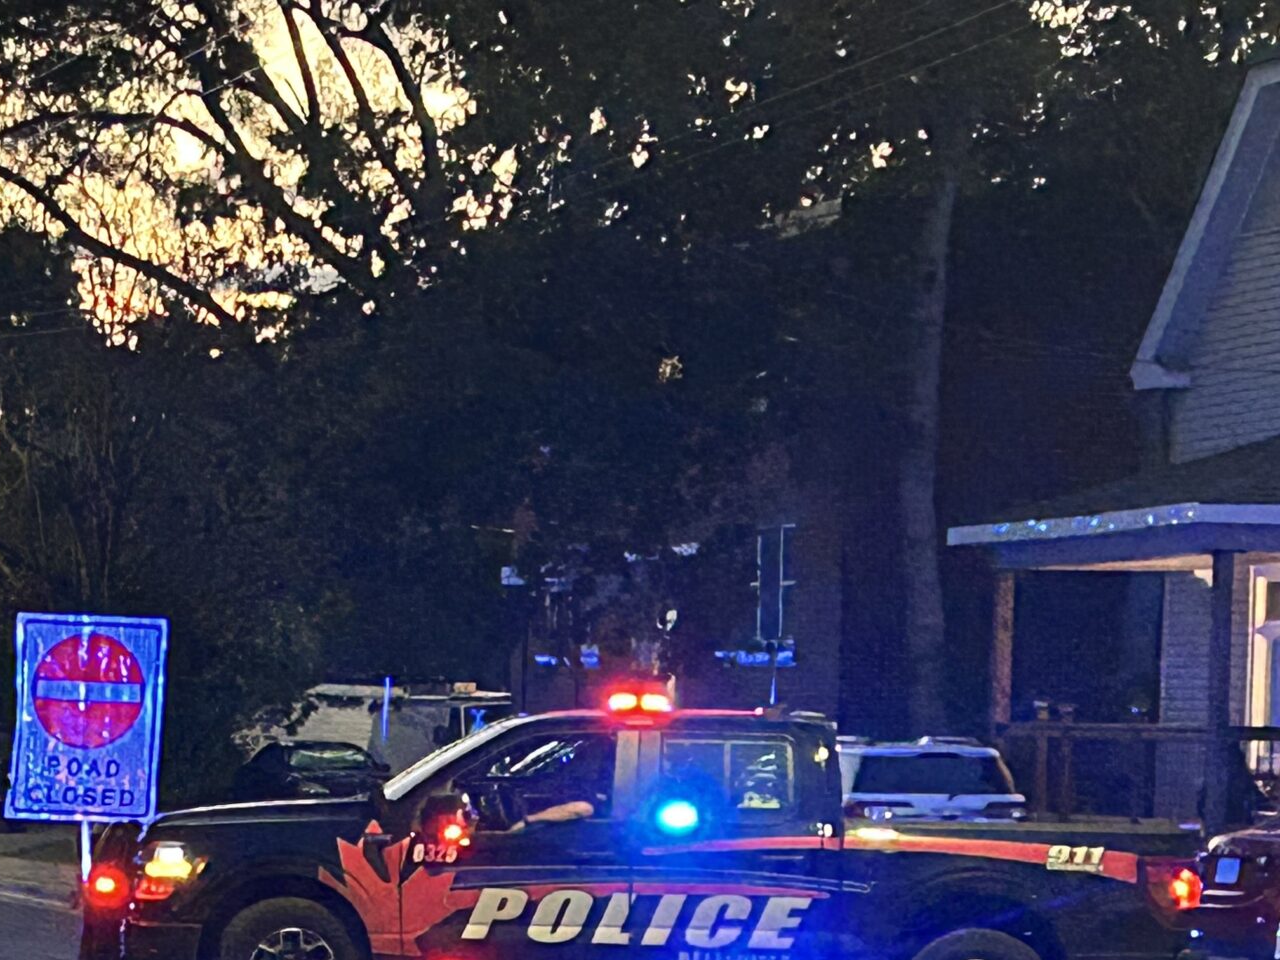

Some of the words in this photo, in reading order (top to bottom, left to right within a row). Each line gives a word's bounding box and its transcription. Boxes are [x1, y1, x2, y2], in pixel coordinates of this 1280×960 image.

[44, 755, 120, 778] ROAD
[28, 783, 135, 807] CLOSED
[1047, 845, 1105, 865] 911
[461, 886, 812, 950] POLICE
